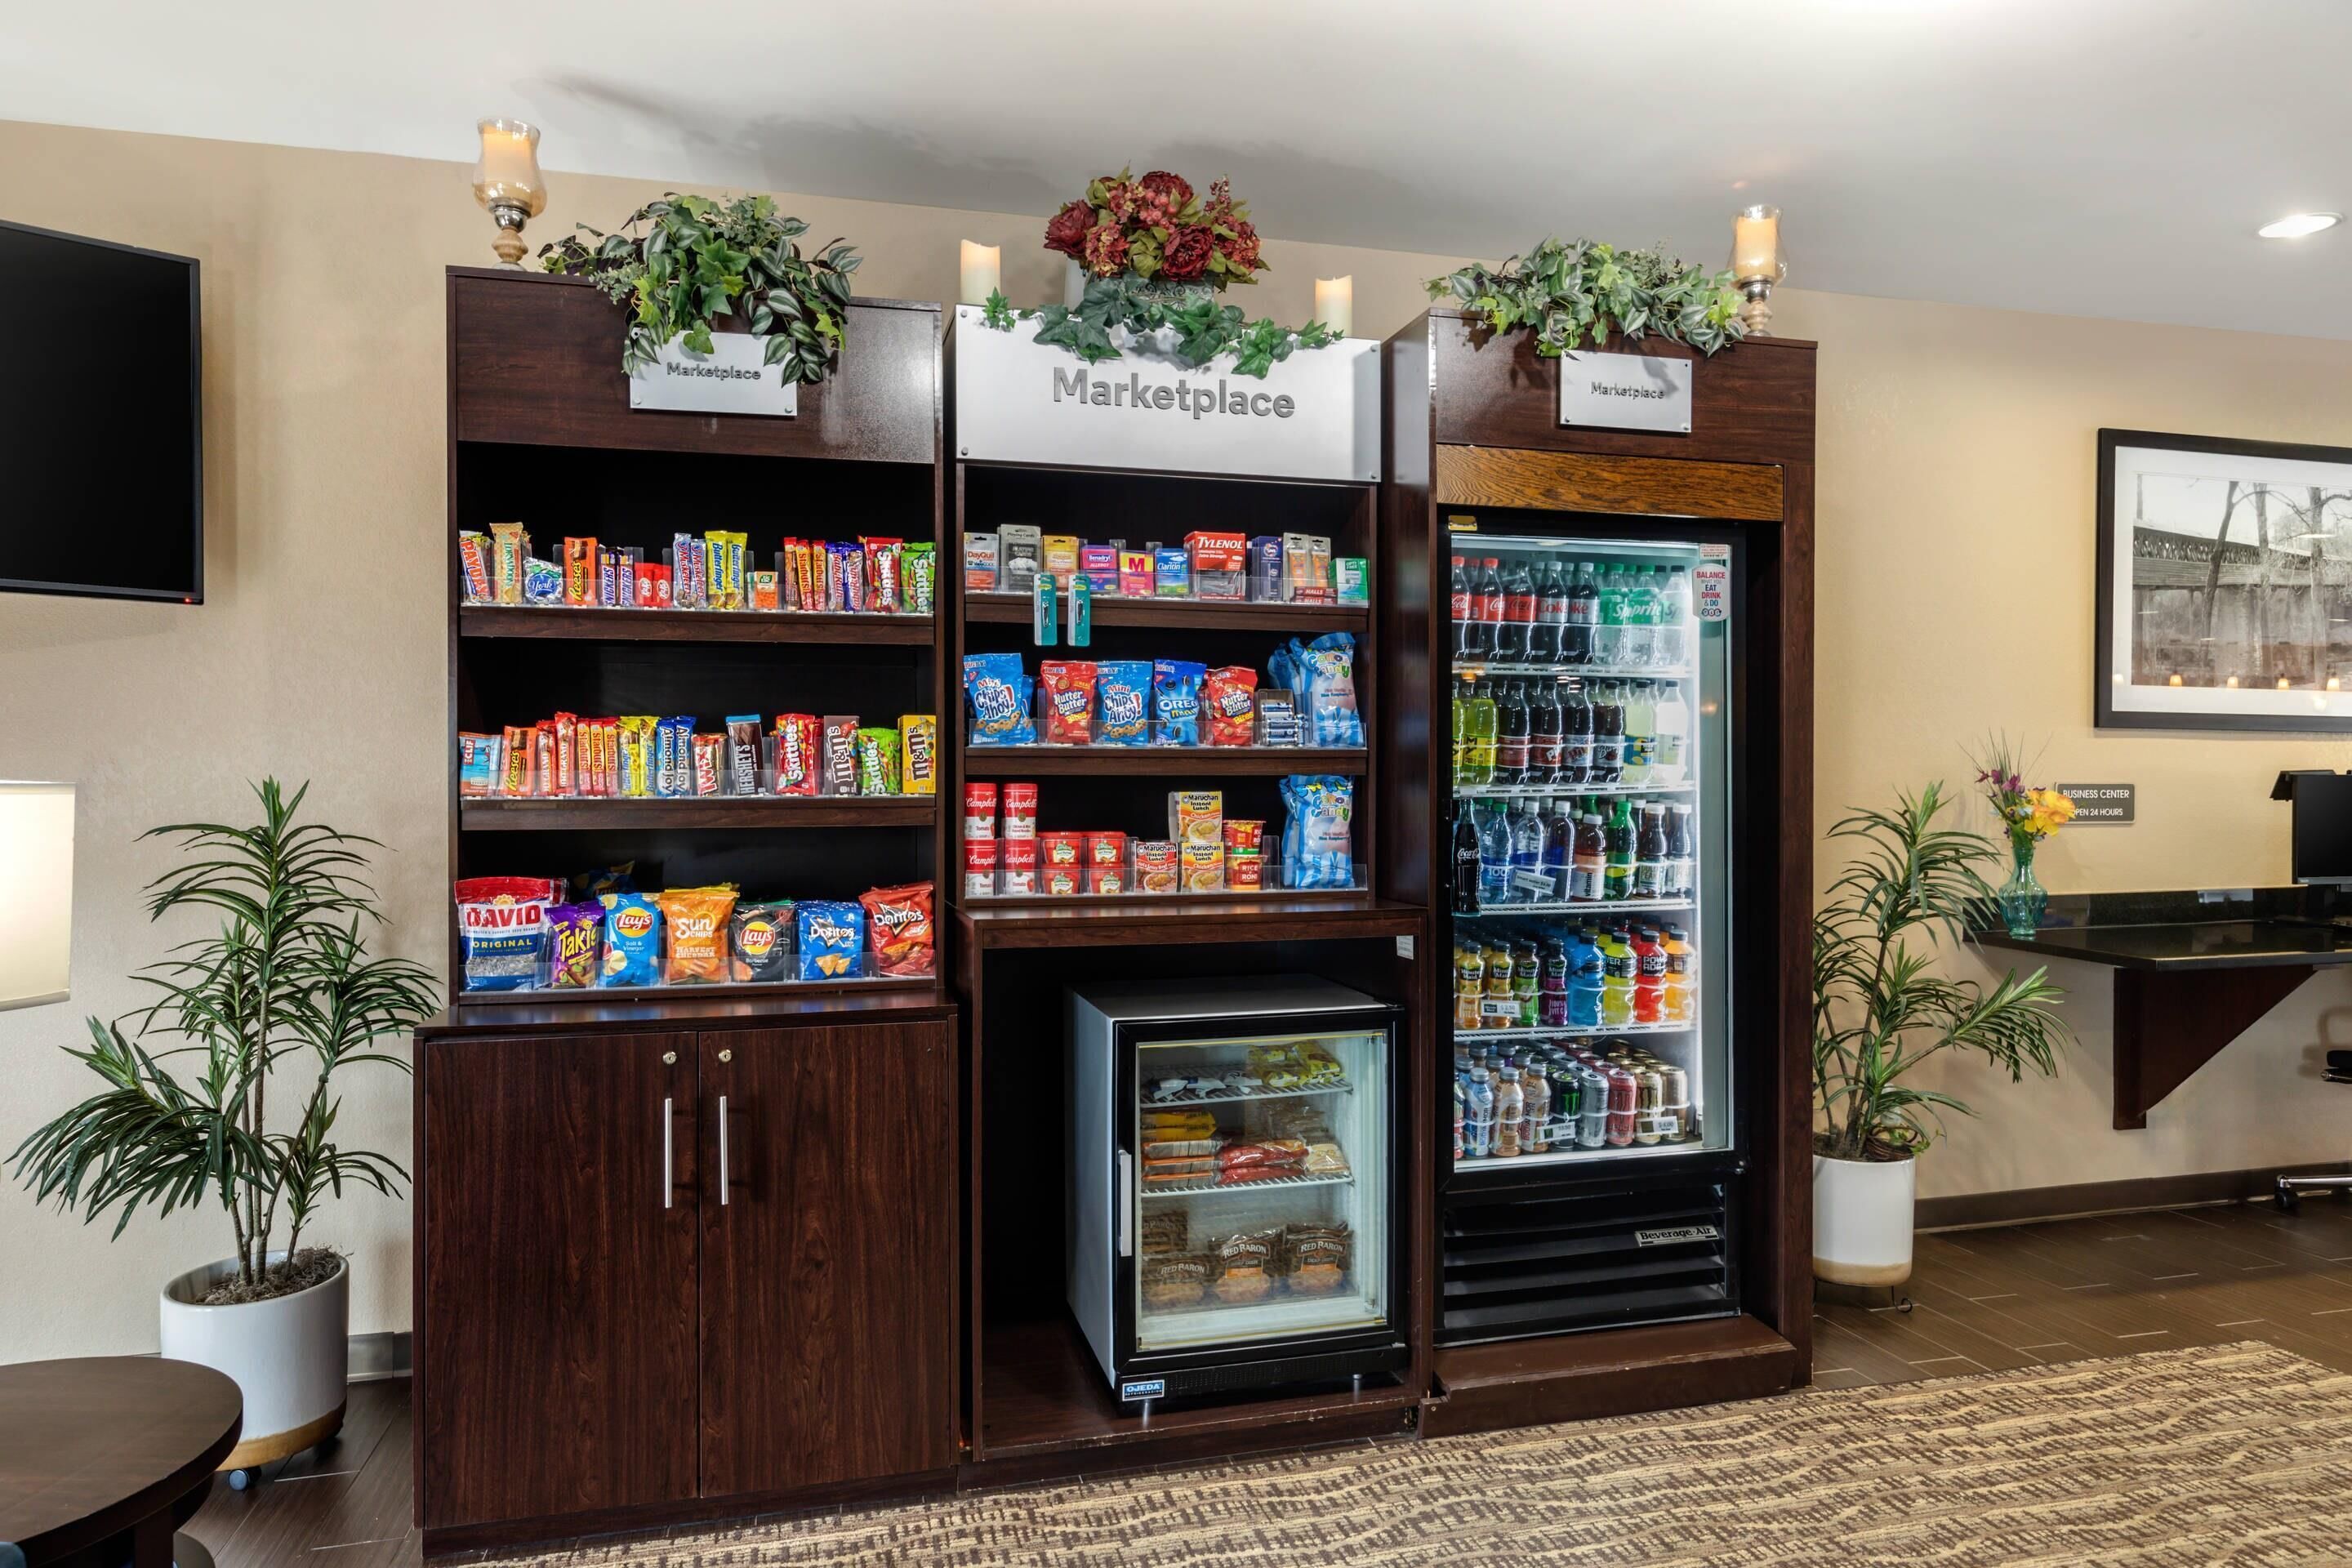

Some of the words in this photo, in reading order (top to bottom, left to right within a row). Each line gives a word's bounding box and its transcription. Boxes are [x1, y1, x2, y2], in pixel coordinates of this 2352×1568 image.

[667, 362, 761, 381] Marketplace
[1054, 367, 1295, 420] Marketplace
[1591, 381, 1665, 399] Marketplace
[1197, 536, 1243, 549] TYLENOL
[968, 552, 995, 560] DayQuil
[460, 541, 489, 595] PAYDAY
[712, 542, 724, 592] Butterfinger
[1157, 562, 1181, 570] Claritin
[1696, 571, 1726, 579] BALANCE
[529, 577, 554, 595] York
[568, 561, 582, 601] Reese's
[876, 550, 894, 606] Skittles
[913, 559, 930, 612] Skittles
[1107, 684, 1131, 693] Mini
[976, 687, 1007, 709] Chips
[1054, 691, 1083, 705] Nutter
[1058, 697, 1087, 715] Butter
[1104, 694, 1134, 711] Chips
[1220, 693, 1249, 708] Nutter
[466, 739, 474, 760] CLIF
[663, 727, 674, 770] Almond
[677, 726, 688, 770] Almond
[784, 722, 804, 782] Skittles
[505, 751, 520, 791] Reese's
[735, 744, 755, 795] HERSHEY'S
[864, 741, 886, 795] Skittles
[662, 771, 674, 793] Joy
[678, 771, 688, 791] Joy
[2062, 789, 2099, 799] BUSINESS
[2100, 789, 2130, 799] CENTER
[2090, 808, 2099, 816] 24
[2100, 808, 2123, 816] HOURS
[466, 904, 541, 929] DAVID
[618, 914, 651, 930] Lay's
[875, 909, 925, 926] Doritos
[675, 916, 716, 939] Sun
[809, 924, 856, 941] Doritos
[473, 938, 533, 949] ORIGINAL
[742, 929, 773, 947] Lay's
[1223, 1245, 1240, 1259] RED
[1239, 1243, 1267, 1254] BARON
[1300, 1243, 1316, 1252] RED
[1316, 1241, 1343, 1251] BARON
[1161, 1265, 1178, 1275] RED
[1178, 1263, 1205, 1274] BARON
[1126, 1383, 1160, 1392] OJEDA
